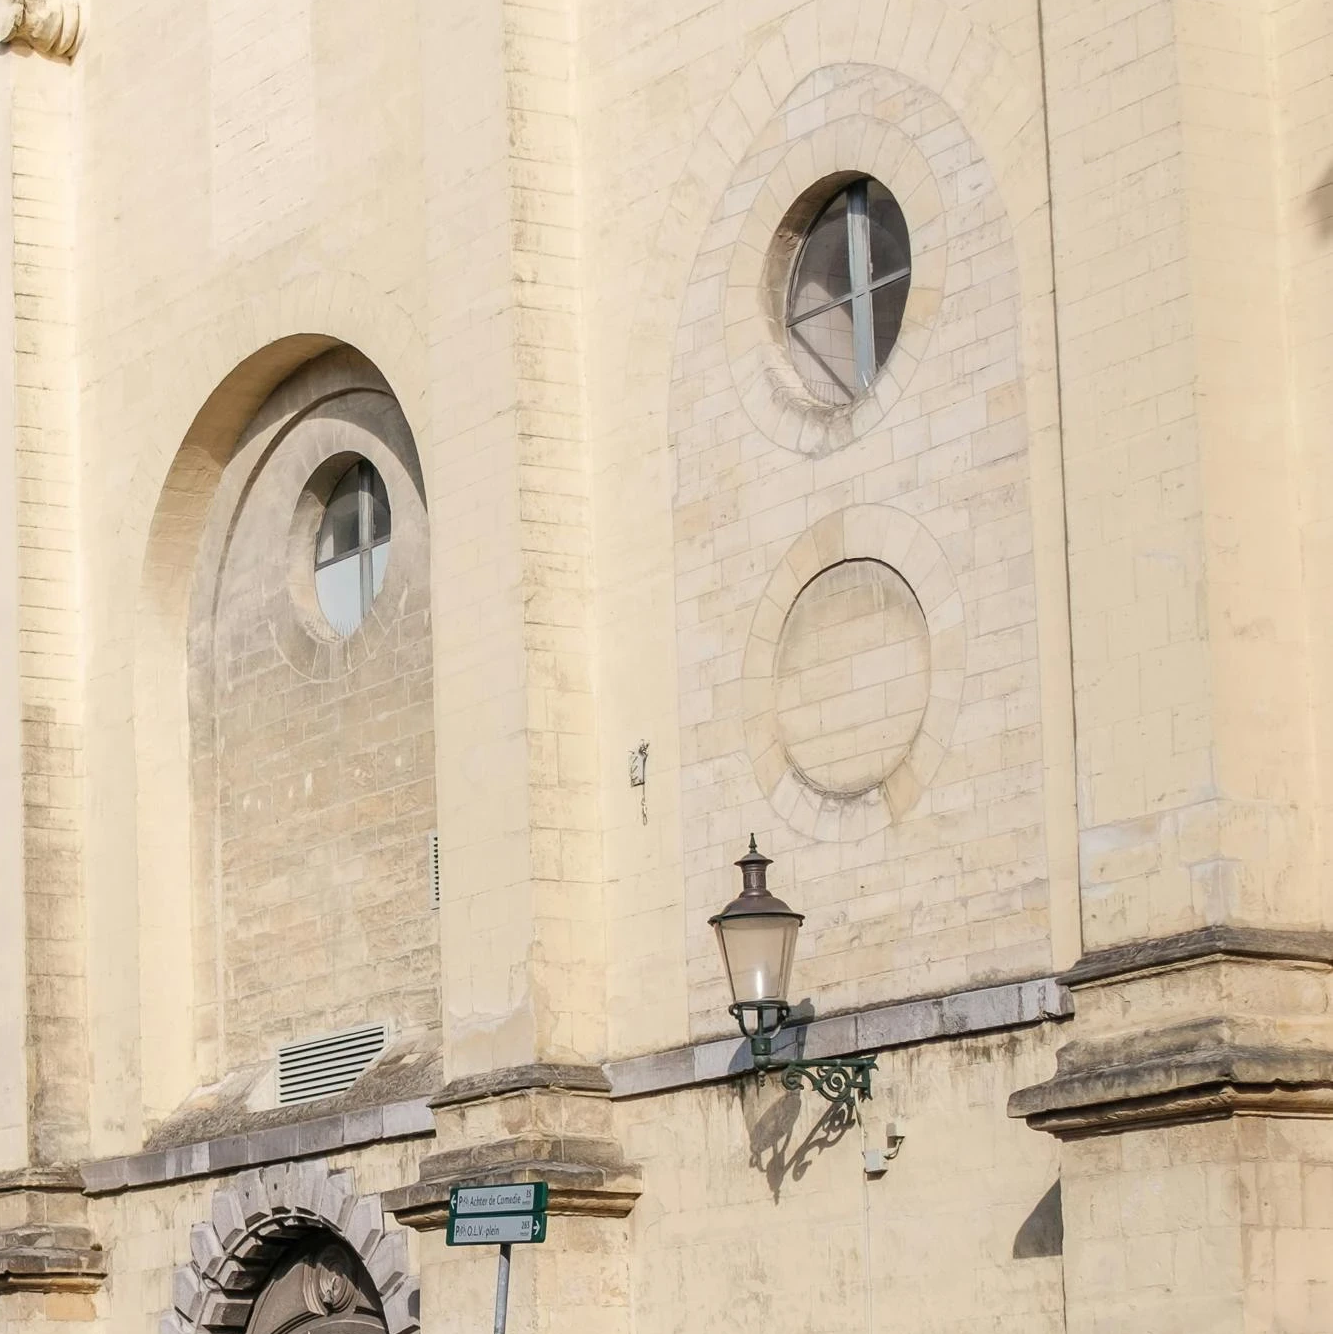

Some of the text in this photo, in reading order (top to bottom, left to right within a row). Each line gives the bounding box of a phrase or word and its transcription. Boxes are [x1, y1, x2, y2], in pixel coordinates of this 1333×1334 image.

[470, 1195, 488, 1207] Achter
[489, 1194, 496, 1206] de
[497, 1192, 521, 1205] Comedie
